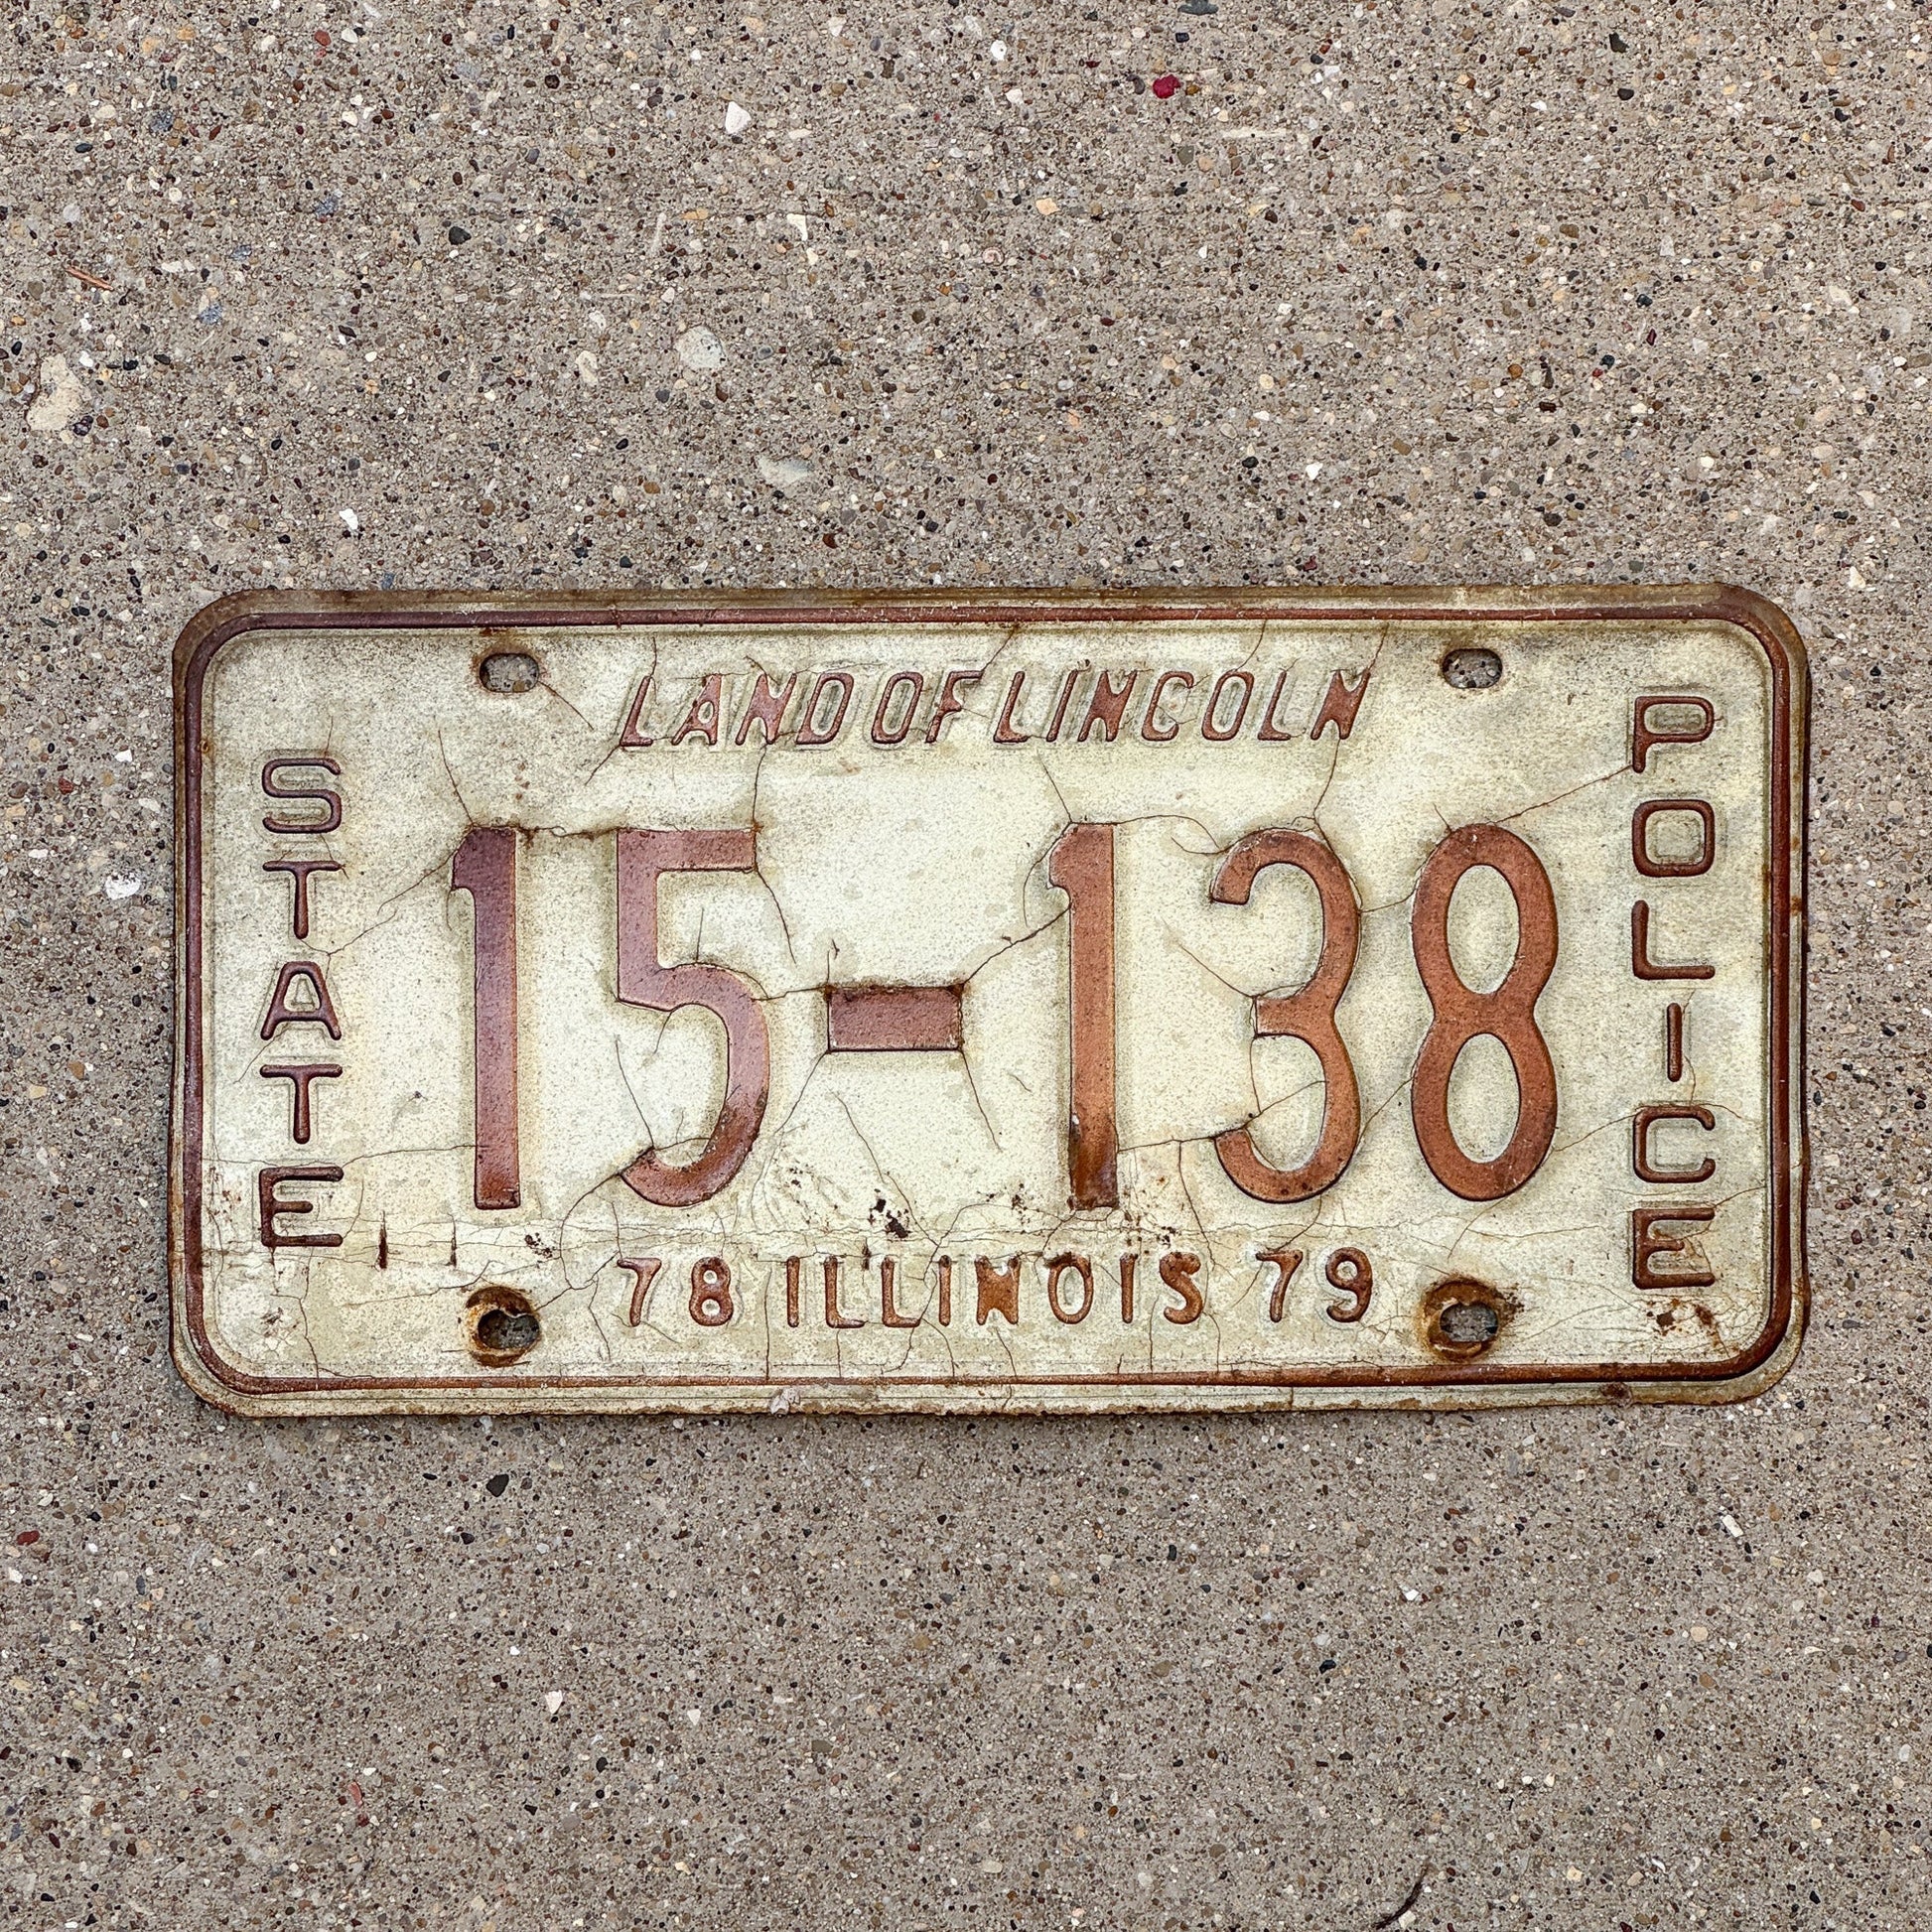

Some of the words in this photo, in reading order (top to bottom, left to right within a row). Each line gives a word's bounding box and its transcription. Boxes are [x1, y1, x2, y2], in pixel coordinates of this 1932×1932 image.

[620, 670, 856, 747] LAND
[871, 669, 983, 745] OF
[993, 669, 1372, 743] LINCOLN
[259, 757, 344, 1249] STATE
[452, 823, 1559, 1210] 15-138
[1632, 695, 1717, 1291] POLICE
[616, 1256, 735, 1328] 78
[786, 1253, 1205, 1329] ILLINOIS
[1256, 1248, 1374, 1323] 79
